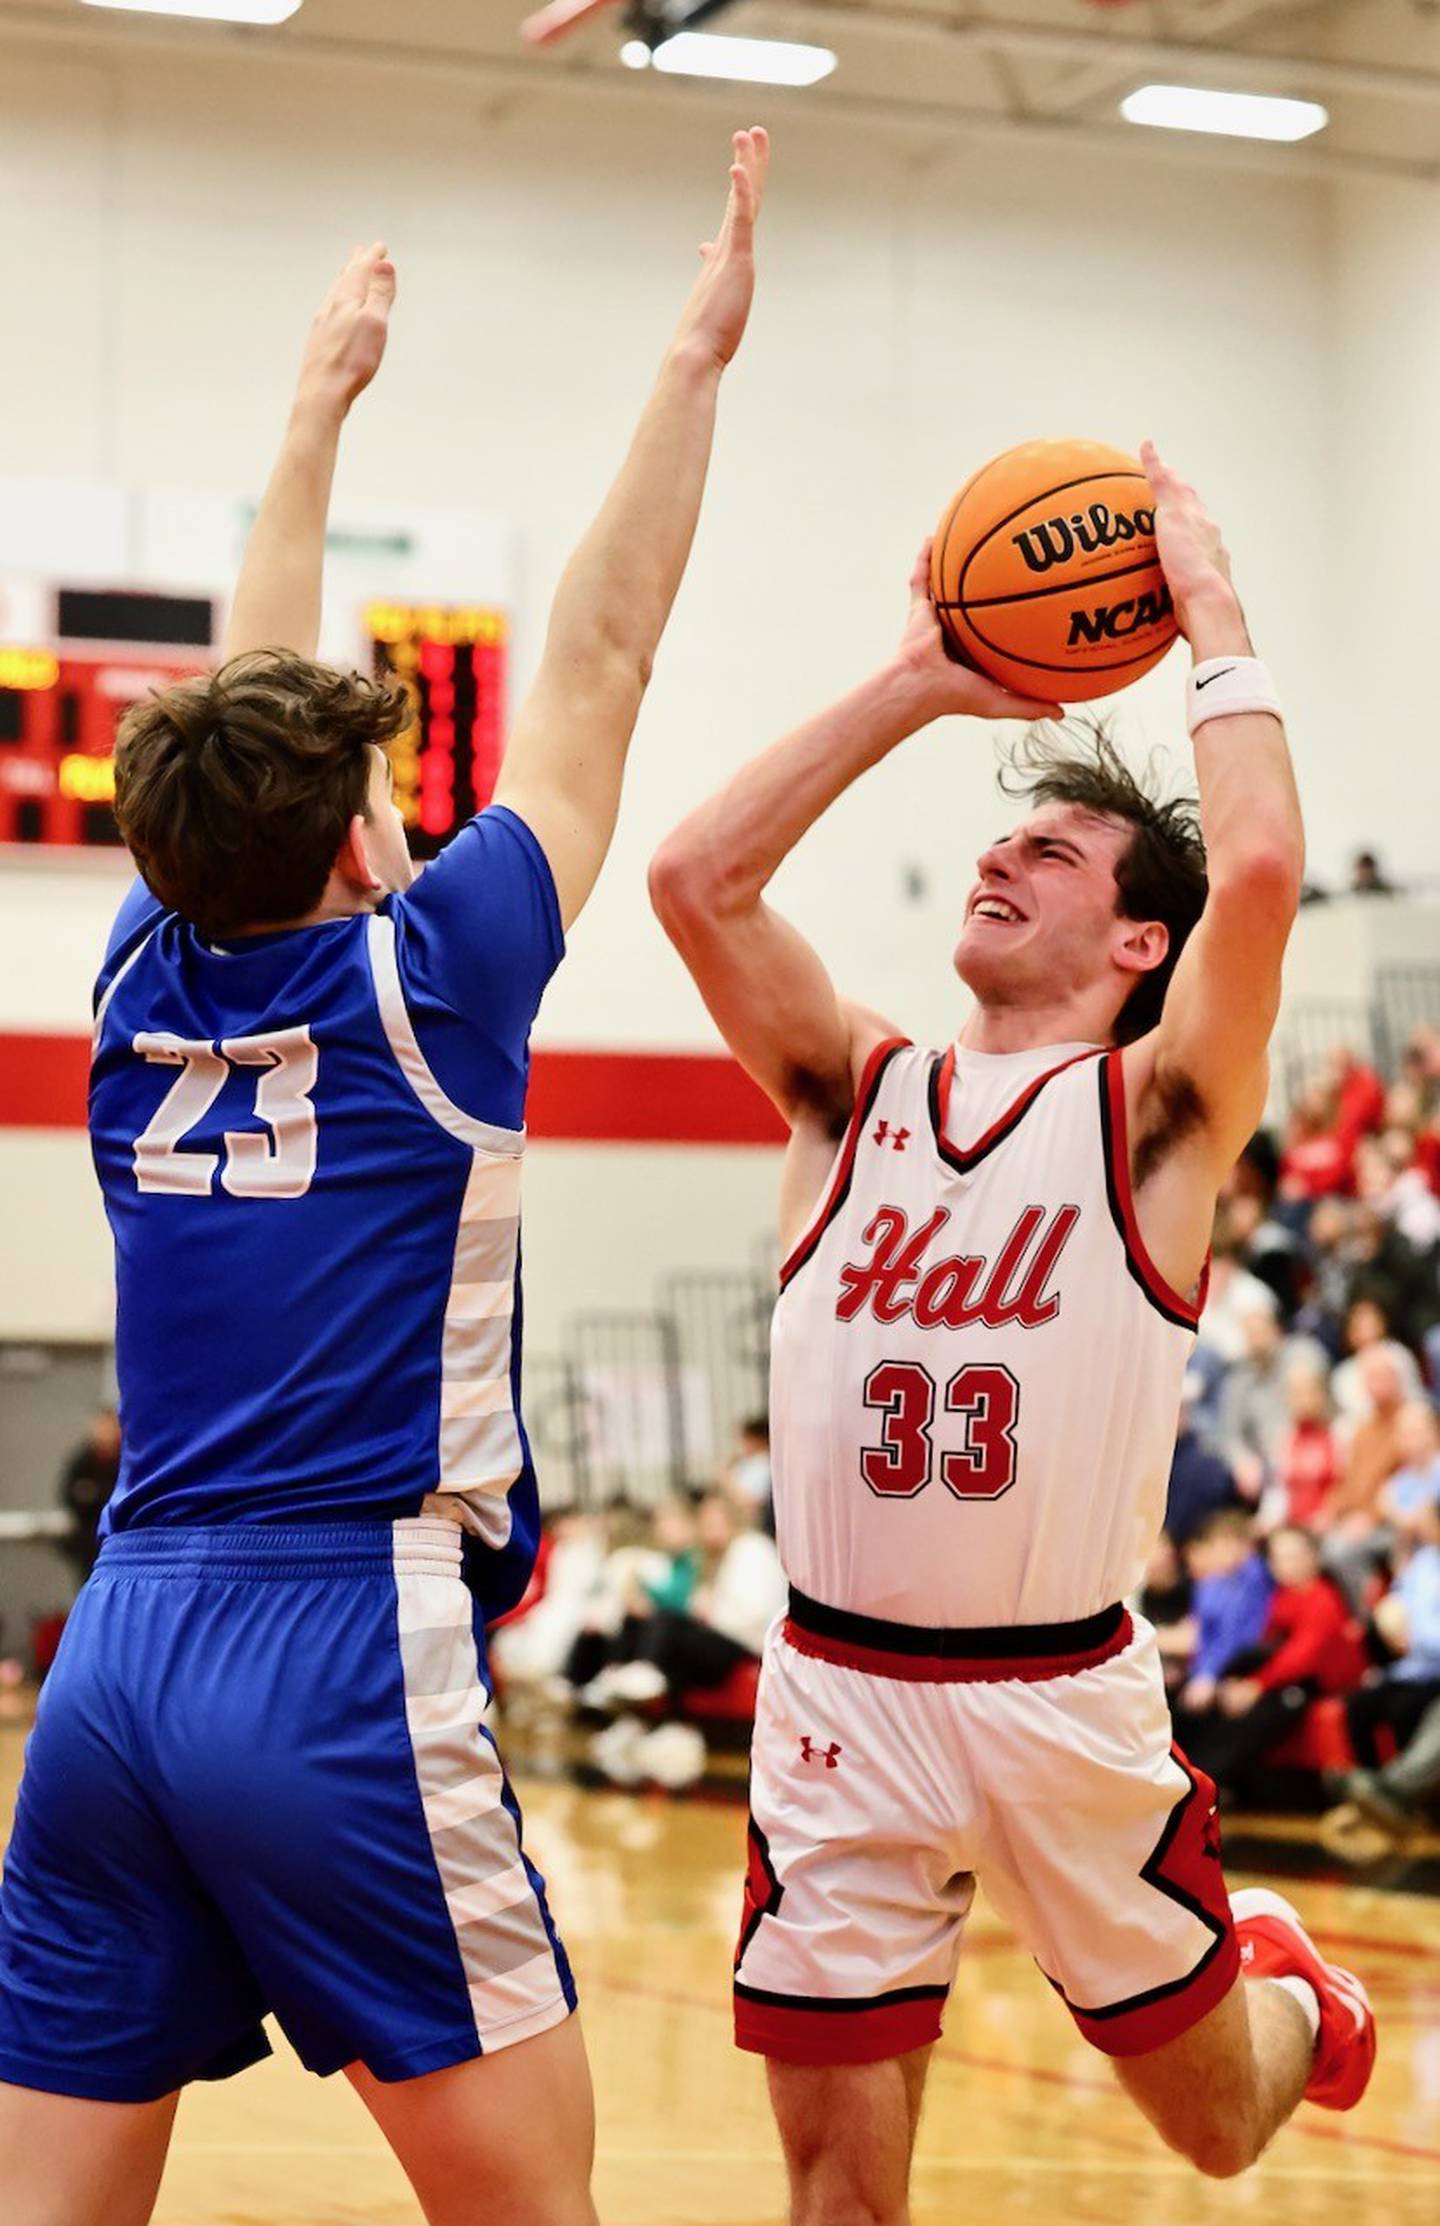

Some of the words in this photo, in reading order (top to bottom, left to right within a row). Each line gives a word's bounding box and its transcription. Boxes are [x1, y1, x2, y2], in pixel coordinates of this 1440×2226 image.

[133, 1025, 319, 1198] 23
[835, 1204, 1081, 1330] Hall
[860, 1359, 1020, 1501] 33
